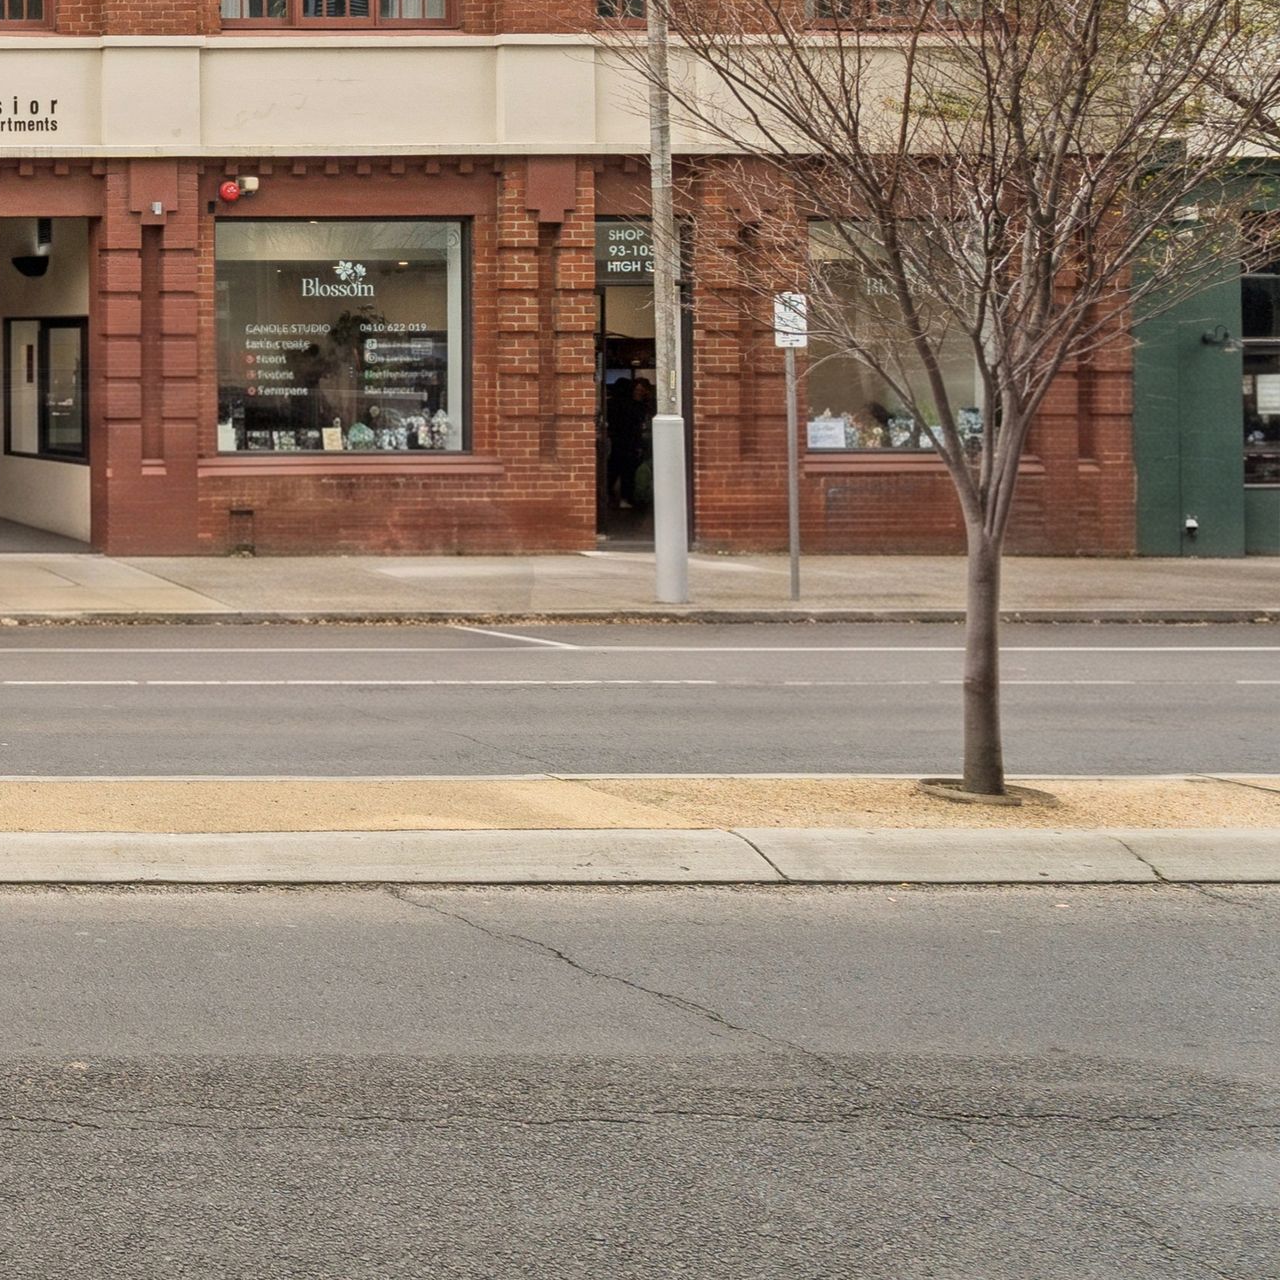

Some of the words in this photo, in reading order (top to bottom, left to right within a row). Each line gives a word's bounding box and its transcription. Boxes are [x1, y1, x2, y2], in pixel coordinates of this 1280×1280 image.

[608, 229, 645, 241] SHOP
[608, 245, 655, 257] 93-103
[607, 261, 641, 273] HIGH
[644, 261, 655, 273] S
[301, 277, 375, 297] Blossom
[245, 323, 289, 334] CANDLE
[290, 323, 331, 334] STUDIO
[359, 323, 385, 332] 0410
[387, 323, 406, 332] 622
[408, 323, 427, 332] 019
